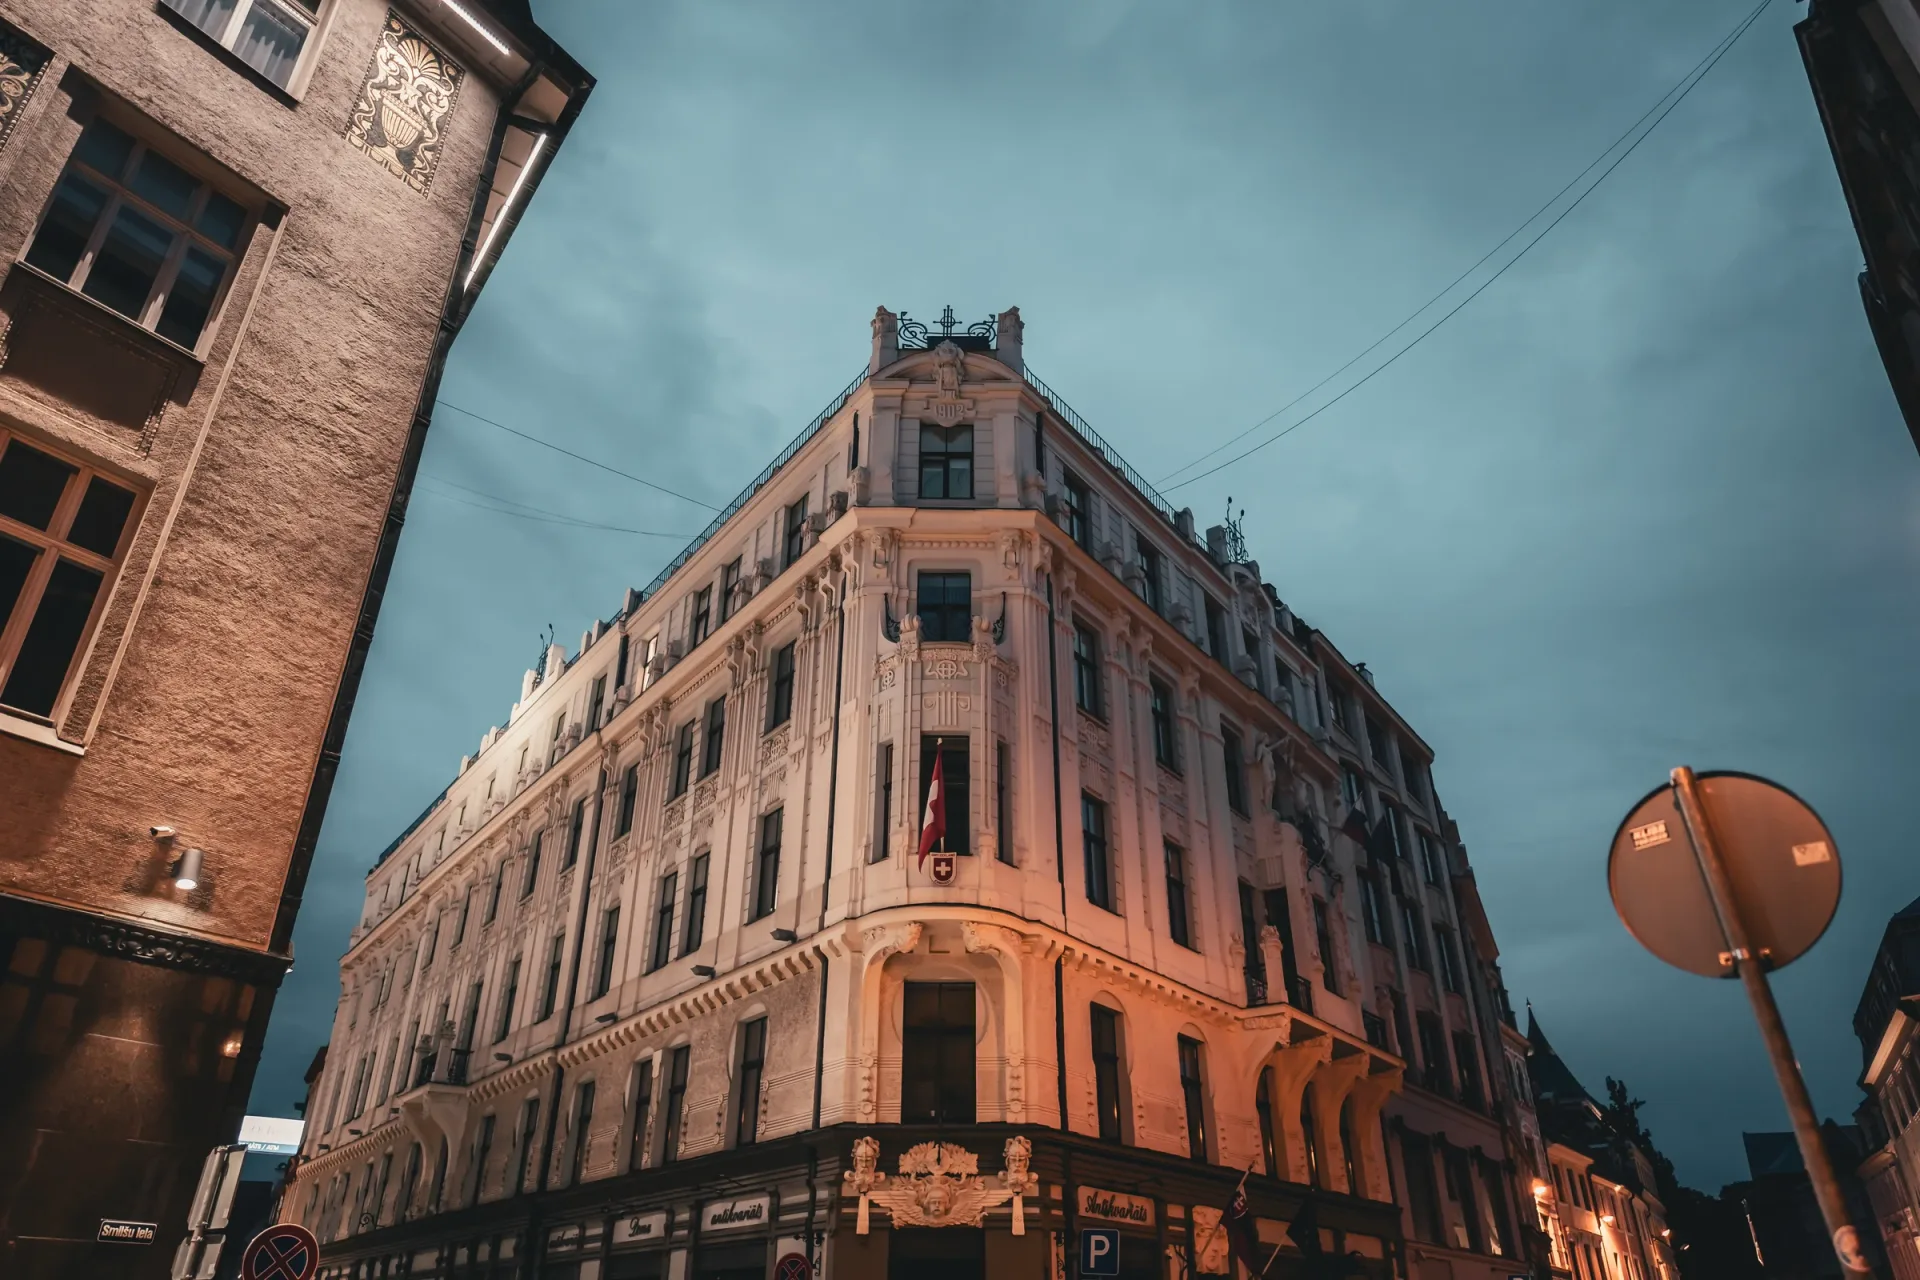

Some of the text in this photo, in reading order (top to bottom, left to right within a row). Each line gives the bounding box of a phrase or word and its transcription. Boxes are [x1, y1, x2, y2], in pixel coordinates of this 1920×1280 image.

[935, 404, 964, 418] 1902
[101, 1224, 135, 1238] Smilšu
[1090, 1234, 1110, 1269] P
